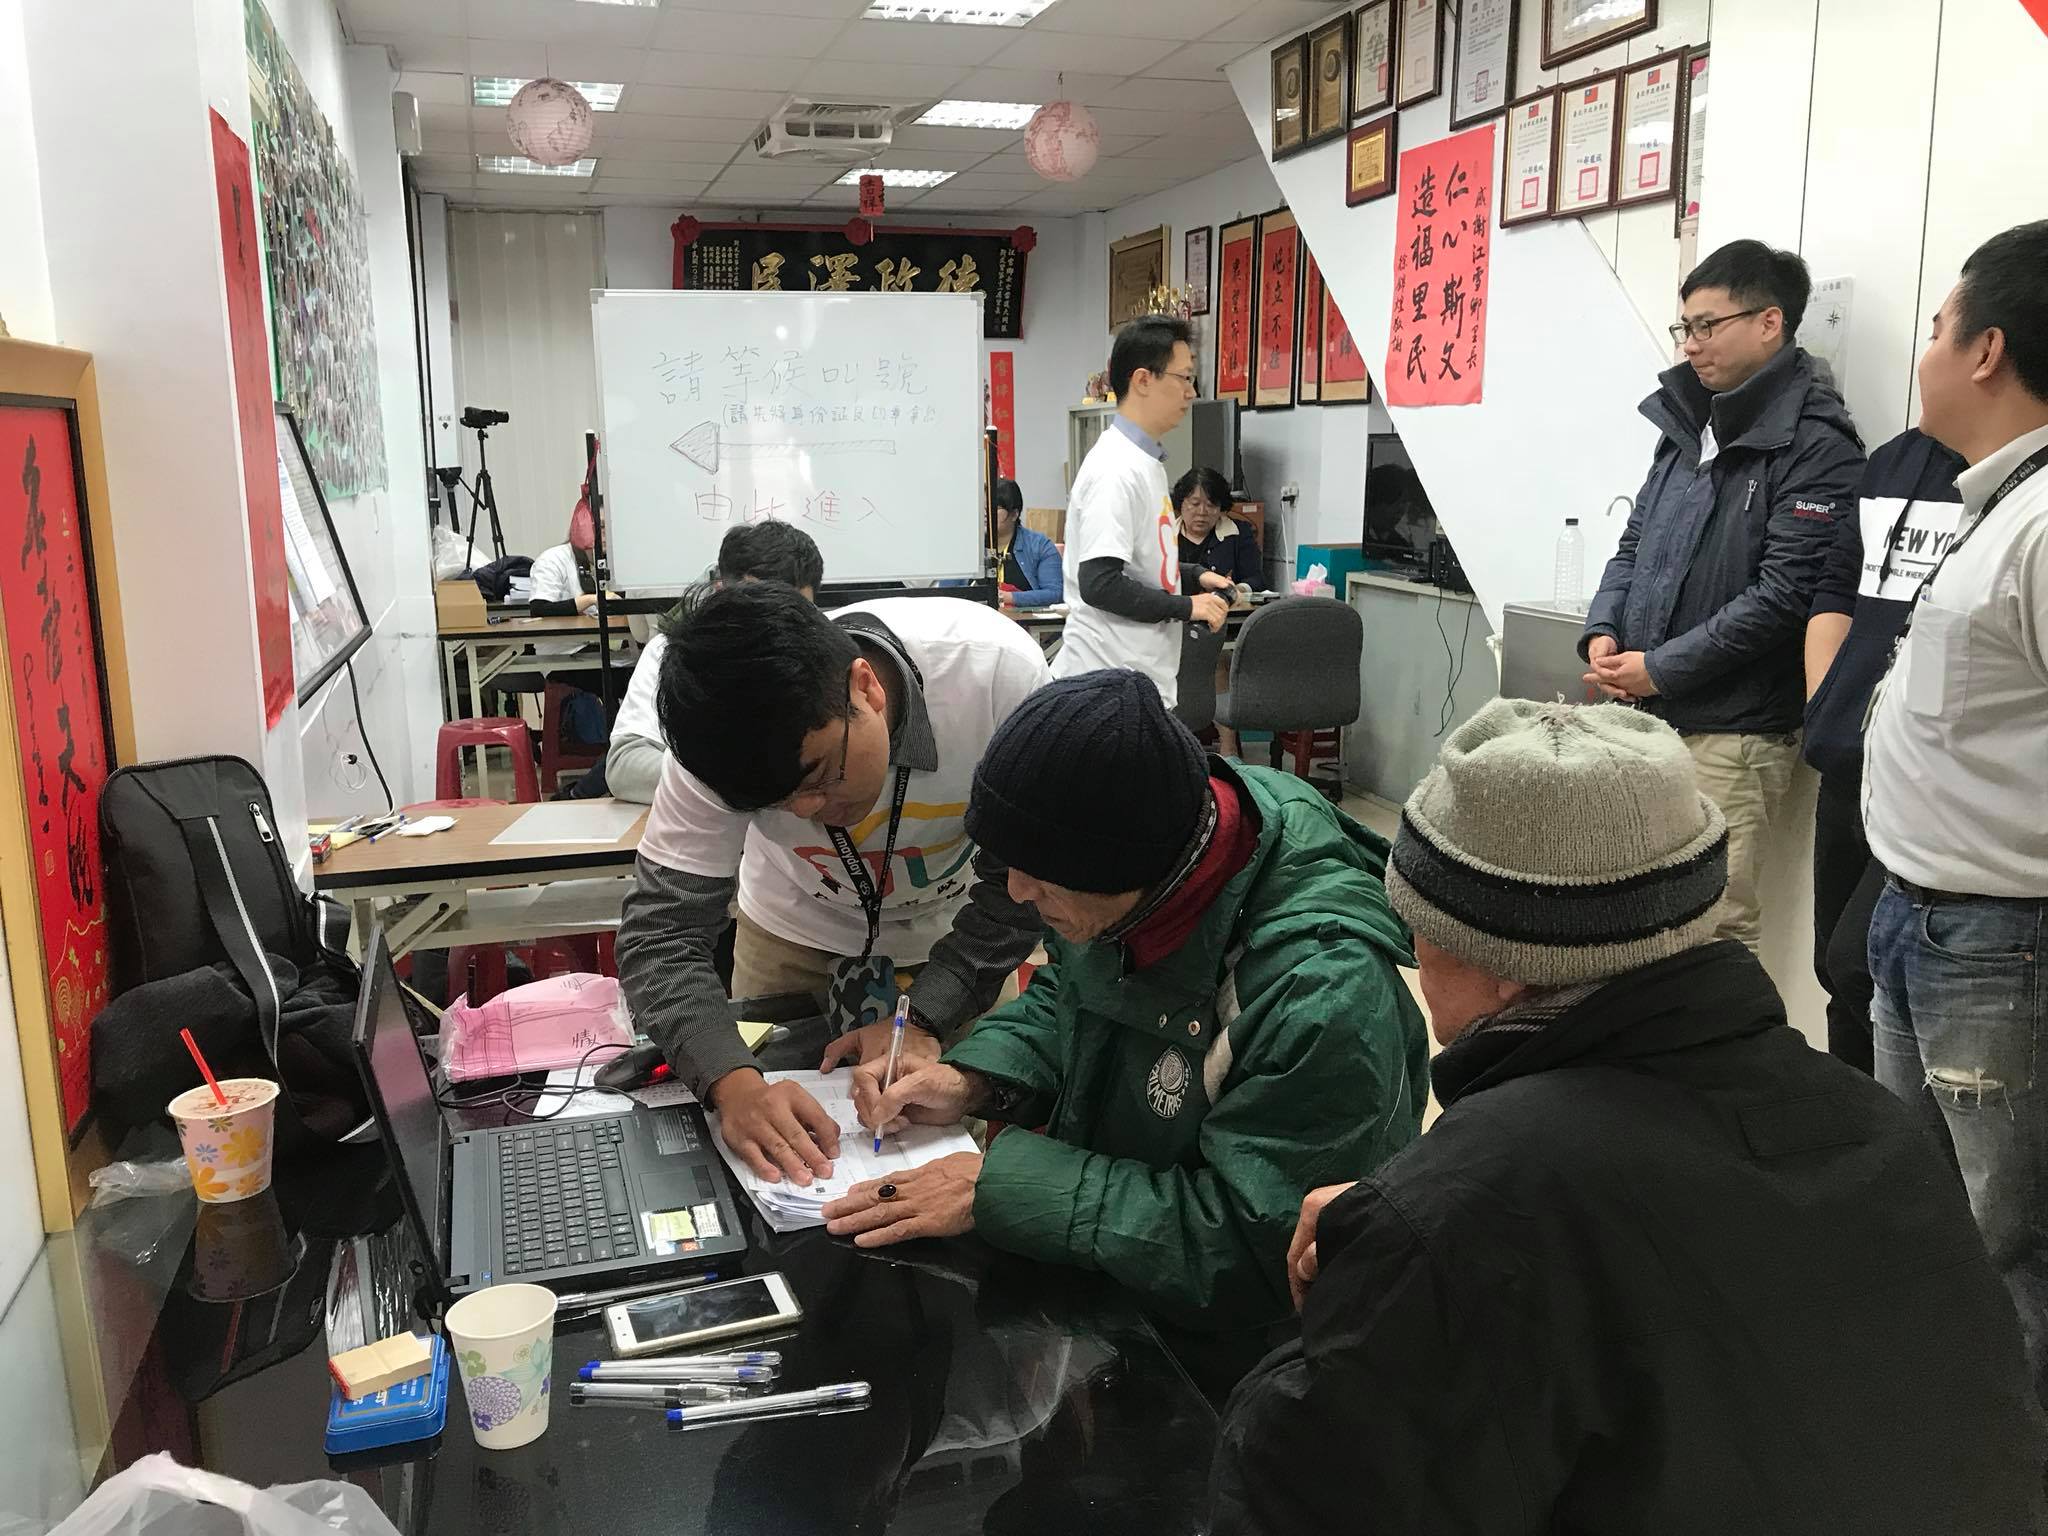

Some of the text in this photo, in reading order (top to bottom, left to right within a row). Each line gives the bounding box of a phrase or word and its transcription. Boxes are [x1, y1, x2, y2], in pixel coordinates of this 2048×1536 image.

[1406, 165, 1438, 385] 造福里民
[1439, 160, 1469, 382] 仁心斯文
[652, 345, 928, 405] 請等候叫號
[695, 484, 896, 530] 由此進入
[834, 832, 864, 877] #mayday
